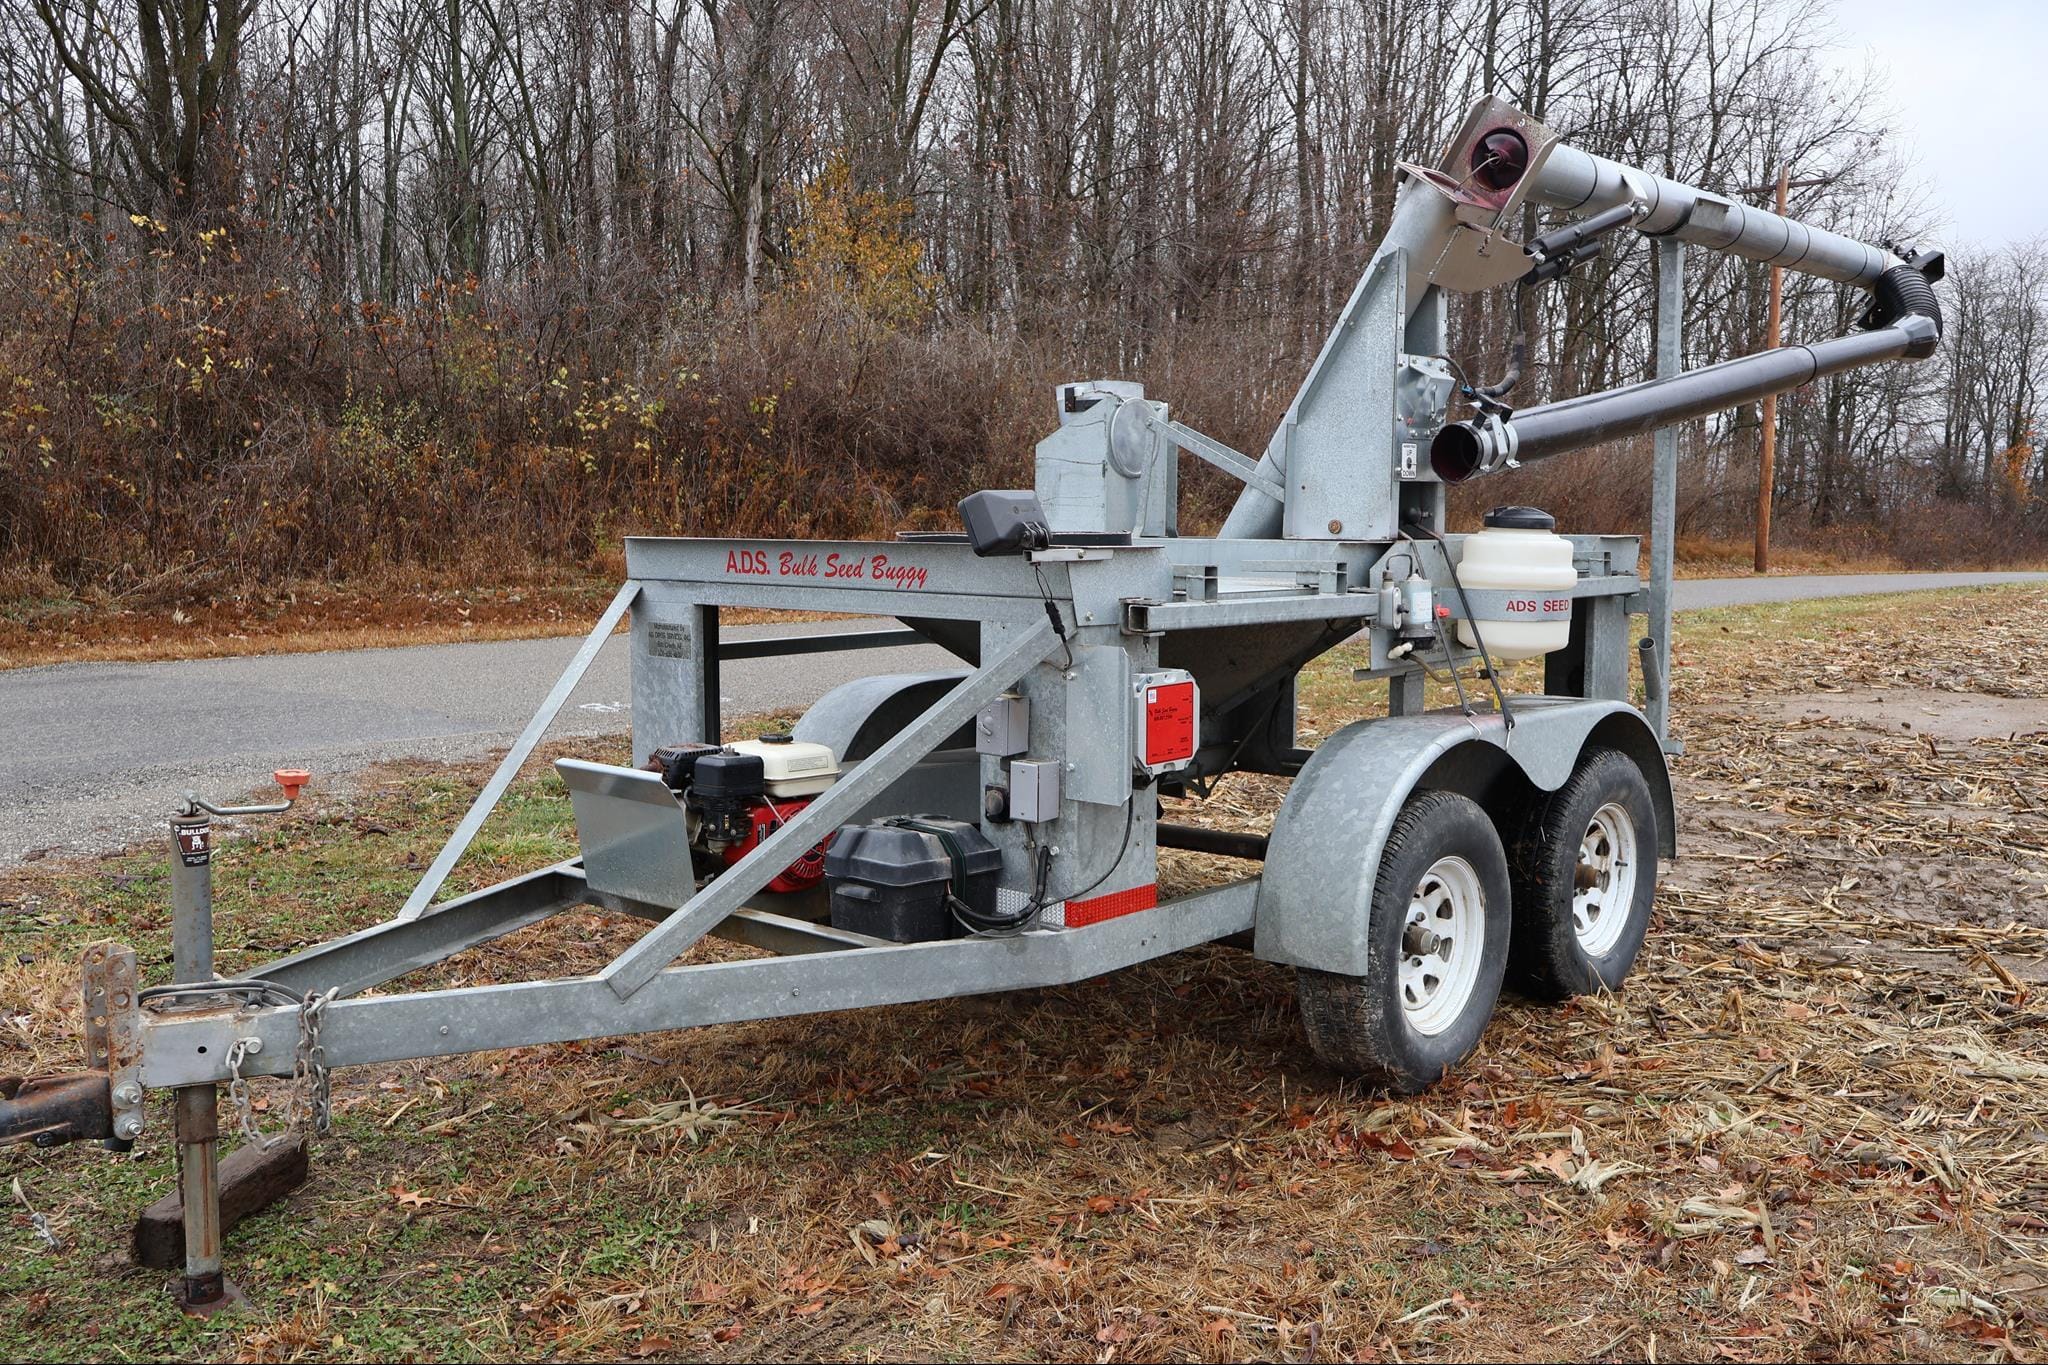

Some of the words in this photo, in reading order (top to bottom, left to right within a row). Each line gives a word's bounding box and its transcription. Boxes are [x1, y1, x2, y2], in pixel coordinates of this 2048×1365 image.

[726, 550, 770, 575] A.D.S.
[779, 551, 819, 577] Bulk
[825, 553, 866, 579] Seed
[871, 554, 929, 589] Buggy
[1505, 600, 1537, 612] ADS
[1543, 600, 1570, 612] SEED
